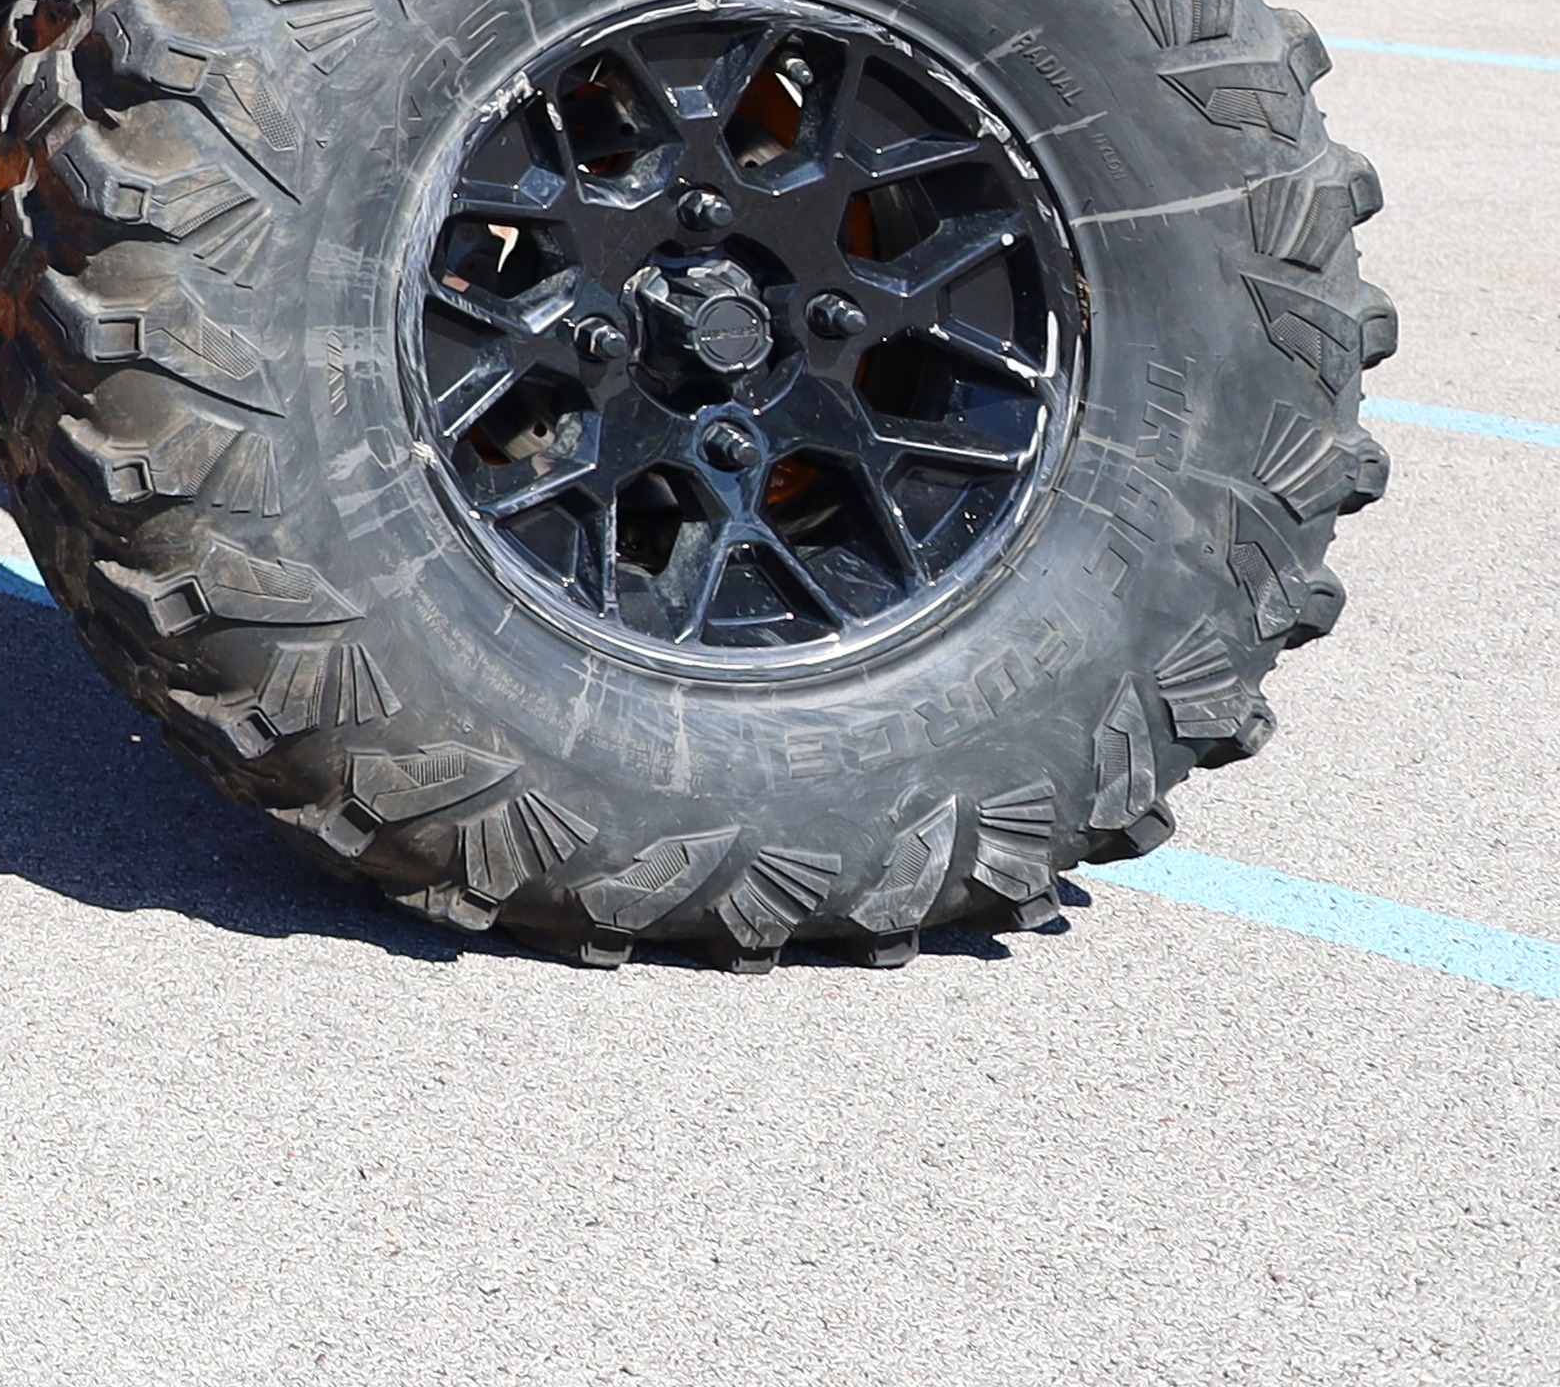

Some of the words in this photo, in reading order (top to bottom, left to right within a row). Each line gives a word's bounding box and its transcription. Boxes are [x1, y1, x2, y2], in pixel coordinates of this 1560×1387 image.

[1010, 30, 1086, 108] RADIAL
[1085, 356, 1193, 598] TRAC
[787, 605, 1085, 781] FORCE
